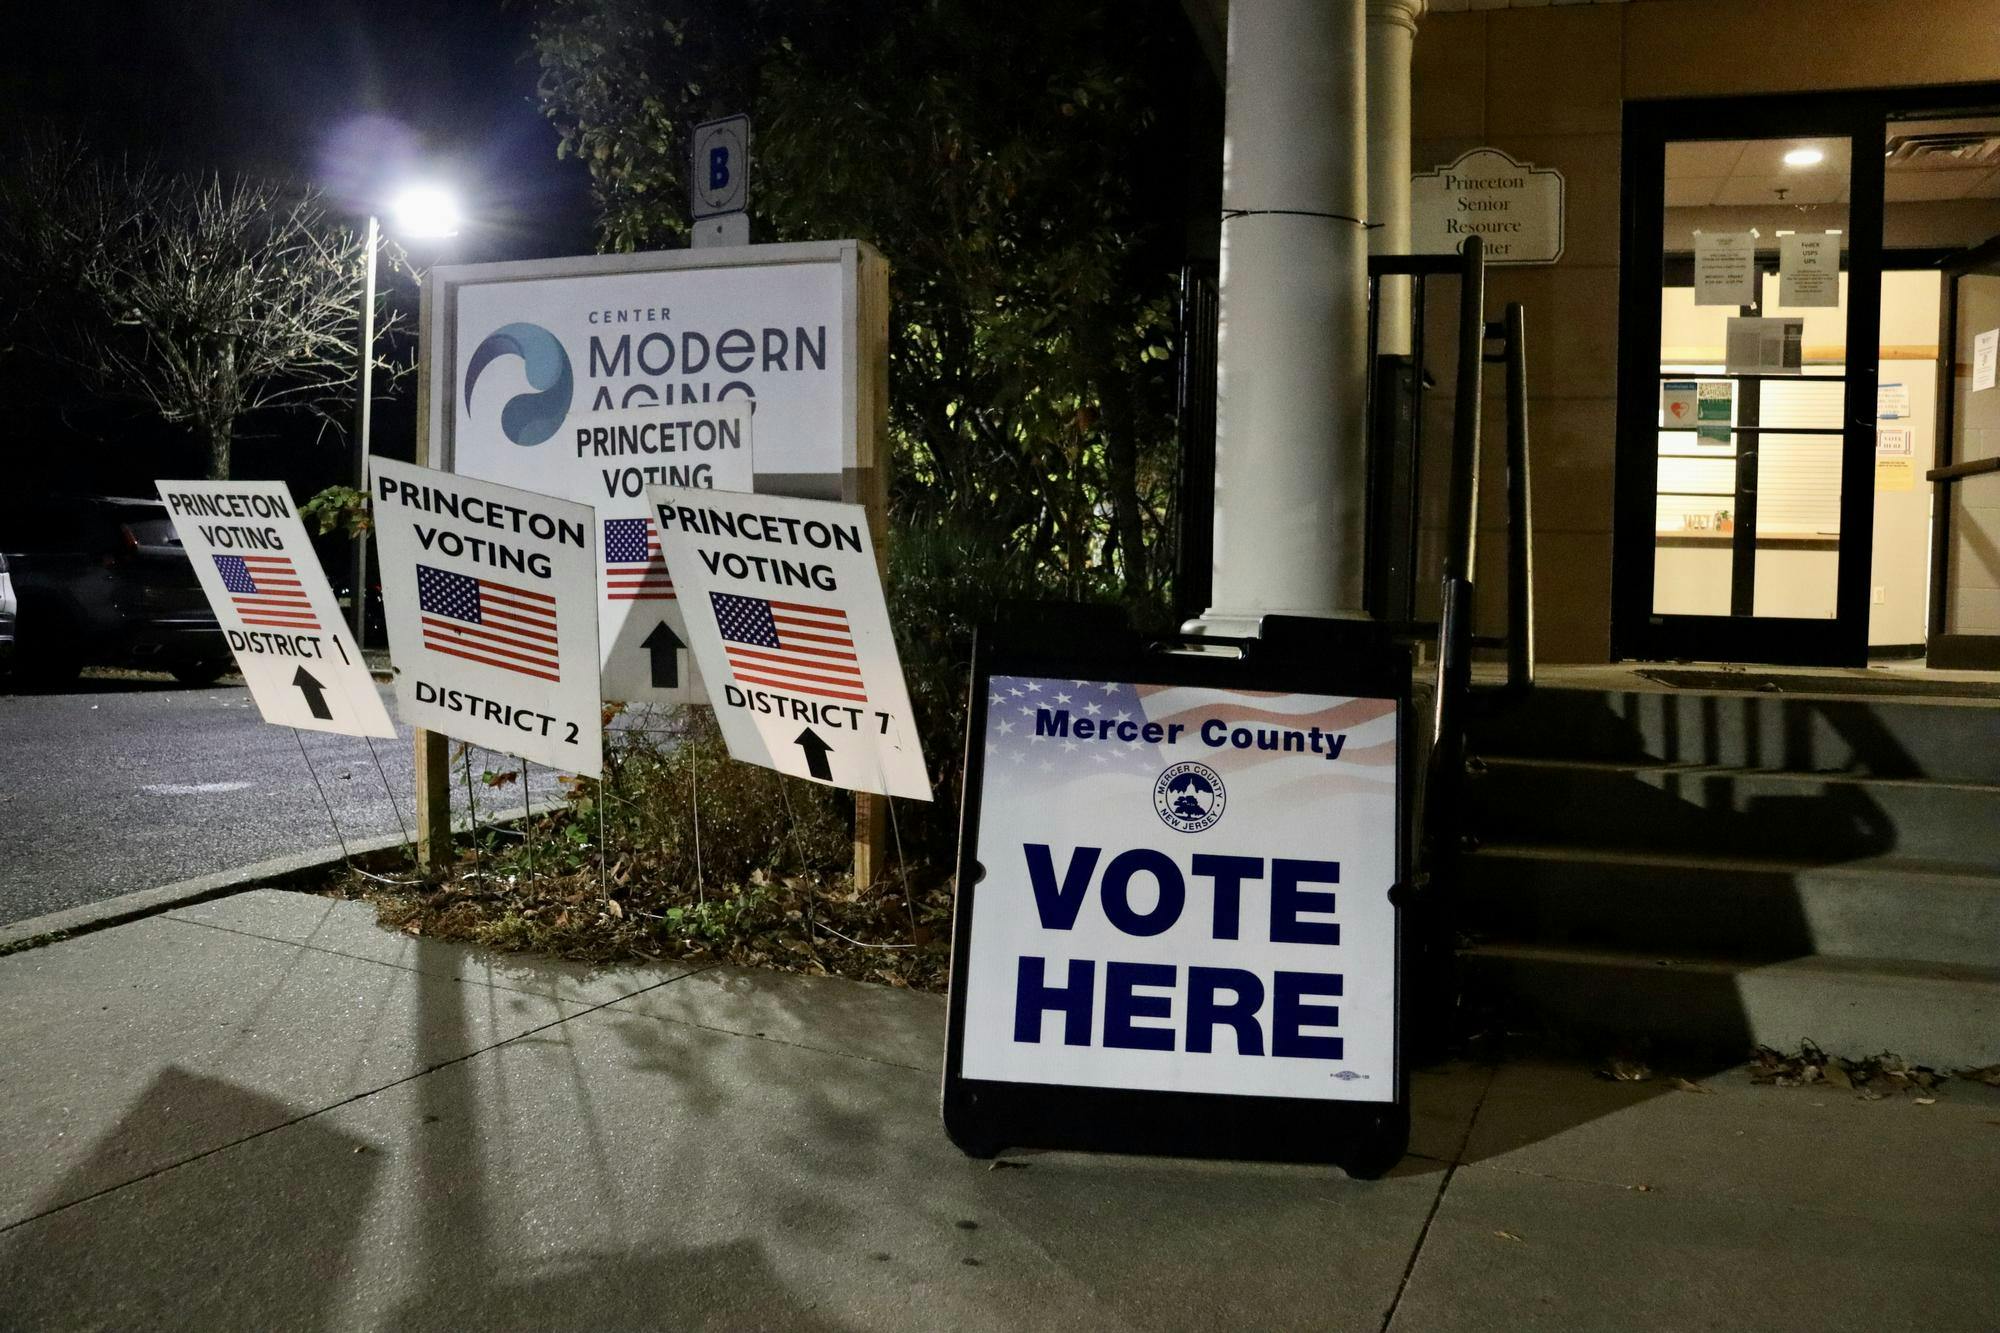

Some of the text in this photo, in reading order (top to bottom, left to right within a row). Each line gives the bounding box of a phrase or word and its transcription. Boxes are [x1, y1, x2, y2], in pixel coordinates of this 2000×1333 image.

[710, 147, 729, 190] B
[1445, 175, 1524, 190] Princeton
[1457, 196, 1512, 211] Senior
[1447, 219, 1521, 234] Resource
[1456, 240, 1512, 255] Cnter
[589, 307, 671, 324] CENTER
[577, 418, 740, 457] PRINCETON
[602, 463, 713, 498] VOTING
[168, 493, 290, 519] PRINCETON
[379, 476, 585, 548] PRINCETON
[200, 525, 284, 550] VOTING
[656, 504, 862, 553] PRINCETON
[413, 524, 552, 579] VOTING
[698, 549, 837, 591] VOTING
[228, 630, 350, 665] DISTRICT 1
[416, 681, 579, 745] DISTRICT 2
[725, 684, 890, 735] DISTRICT 7
[1035, 709, 1346, 760] Mercer County
[1157, 765, 1223, 799] MERCER COUNTY
[1160, 808, 1218, 831] NEW JERSEY
[1023, 843, 1340, 946] VOTE
[1014, 956, 1343, 1060] HERE
